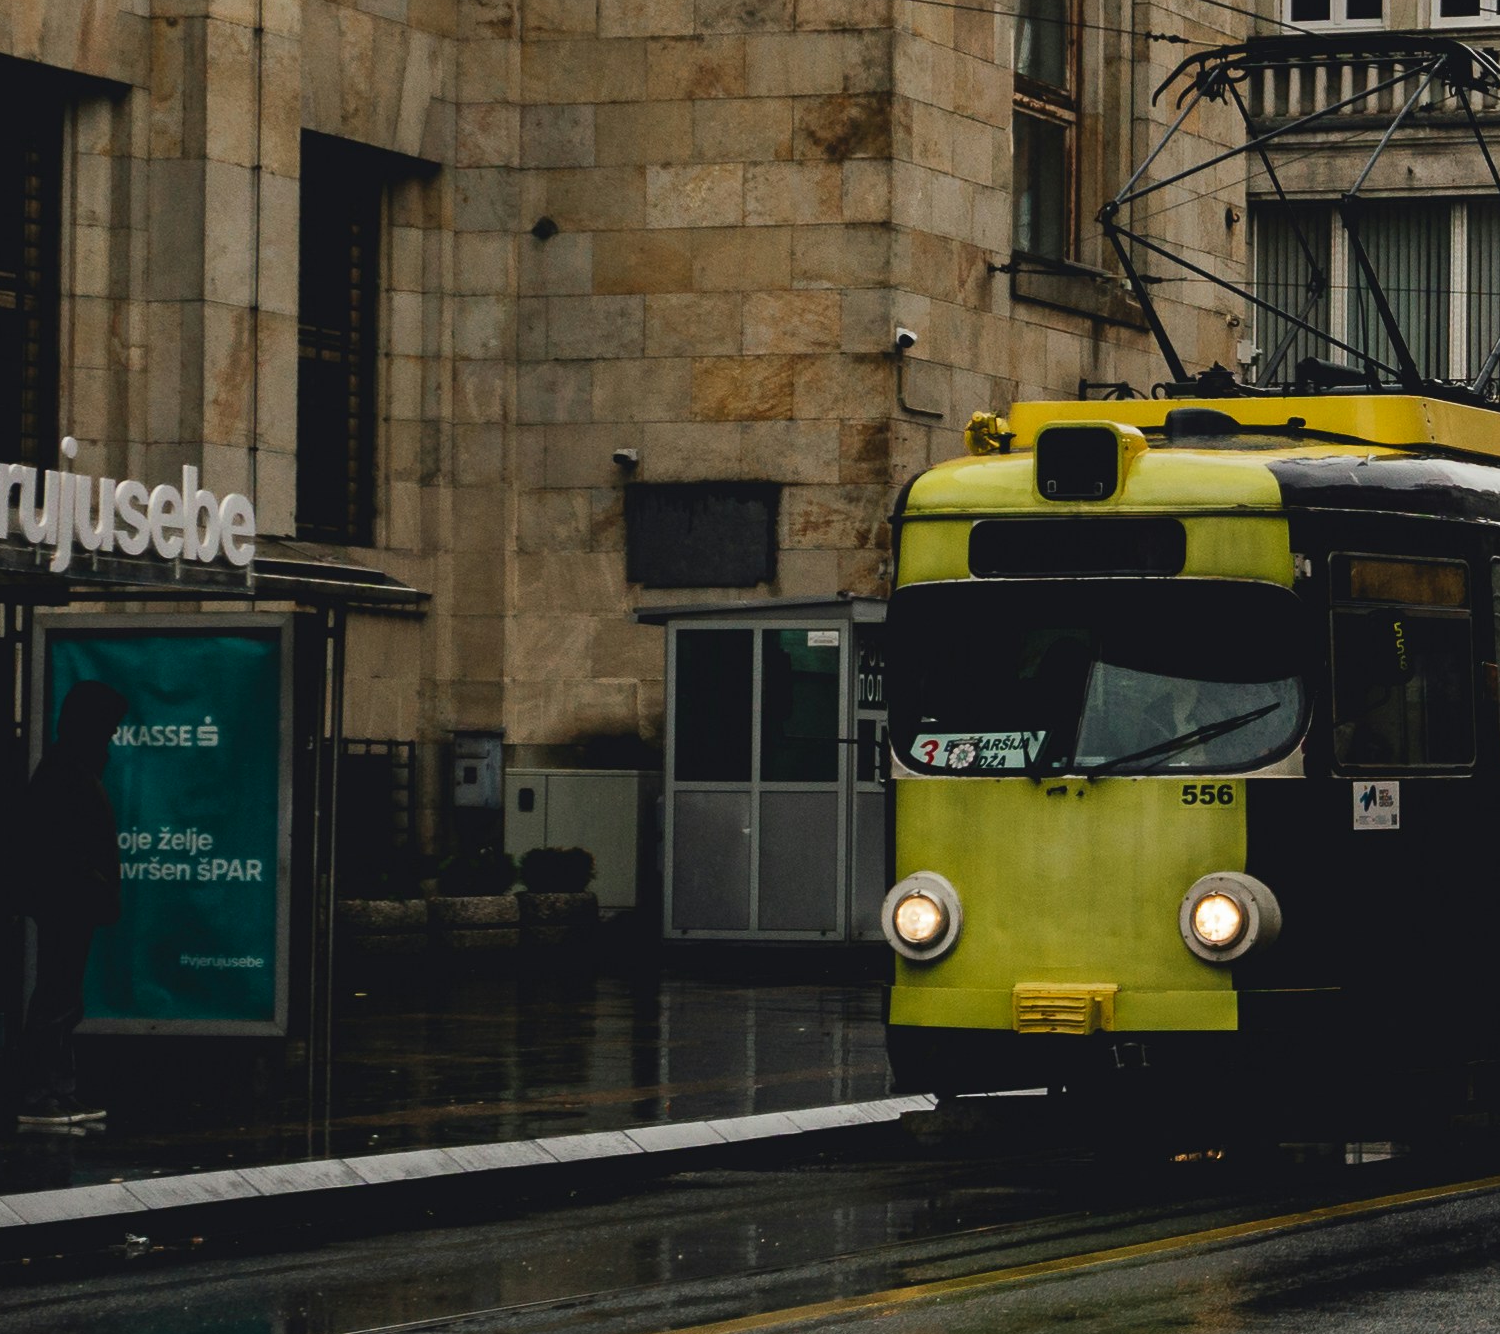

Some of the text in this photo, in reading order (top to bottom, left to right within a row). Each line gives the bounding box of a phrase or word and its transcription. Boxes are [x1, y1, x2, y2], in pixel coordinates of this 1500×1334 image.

[859, 674, 883, 702] ПОЛ
[920, 739, 938, 766] 3
[1181, 784, 1234, 805] 556
[157, 826, 213, 855] želje
[196, 857, 263, 882] šPAR
[180, 953, 264, 969] #vjerujusebe
